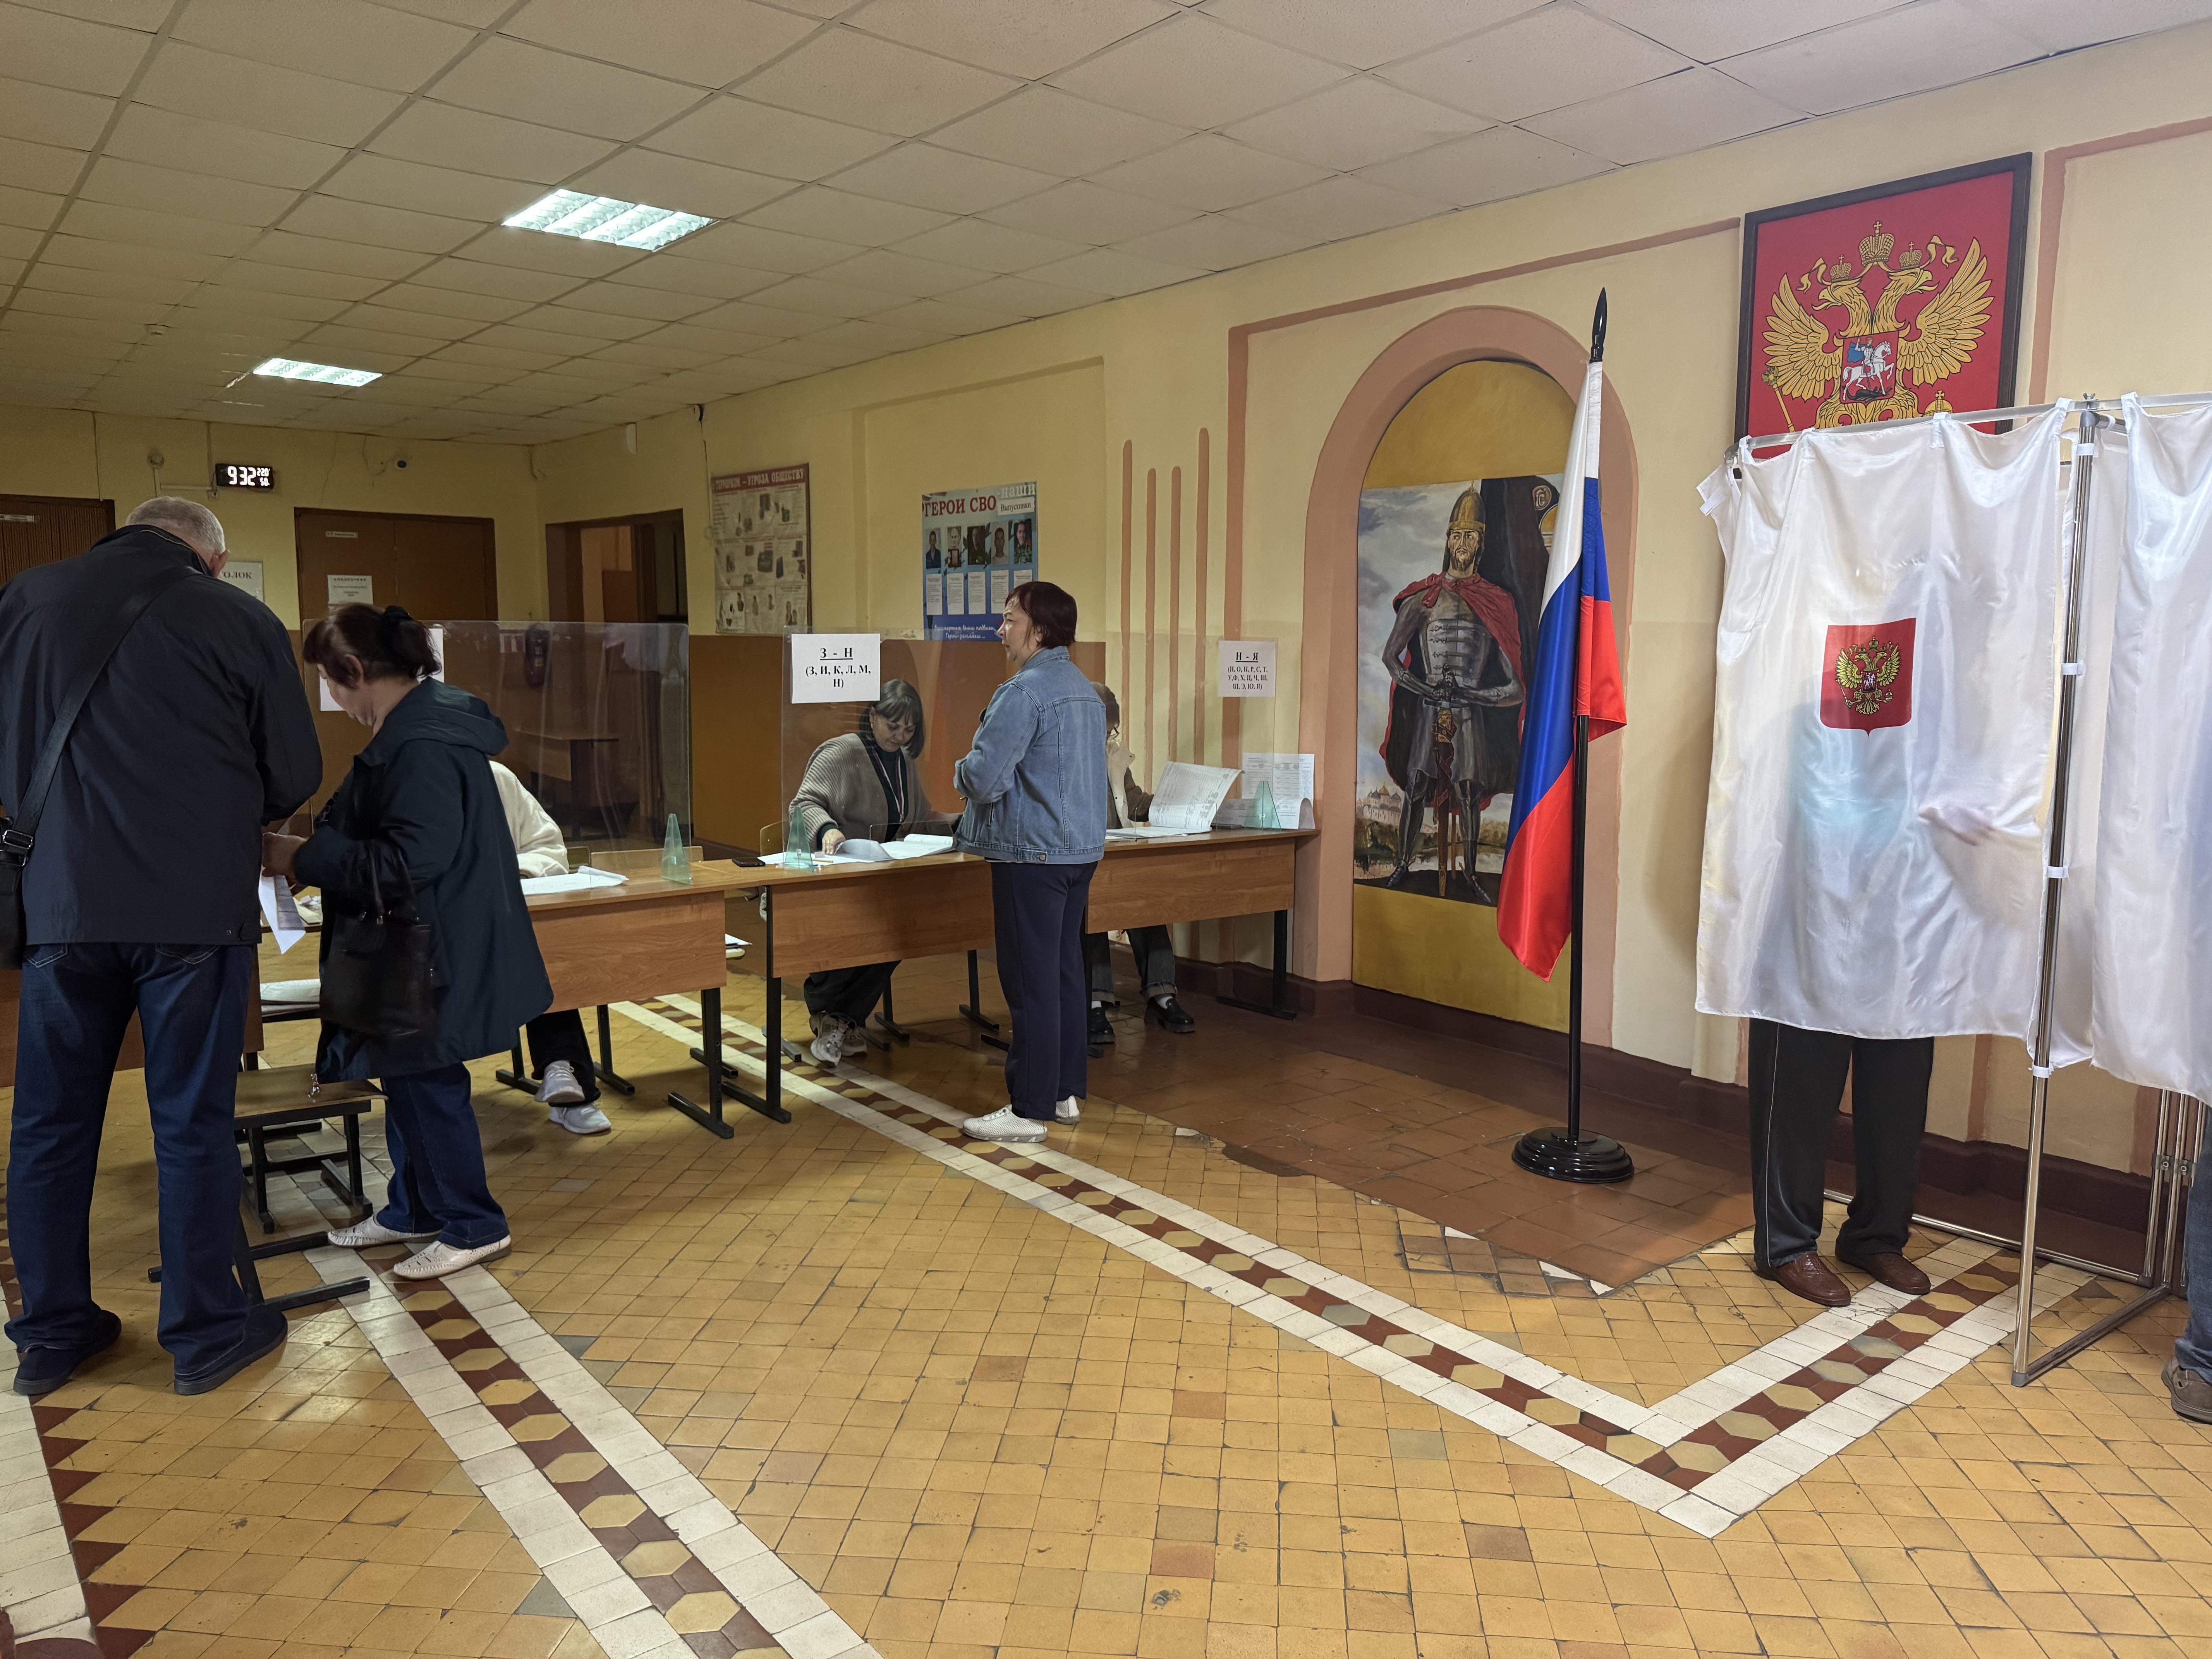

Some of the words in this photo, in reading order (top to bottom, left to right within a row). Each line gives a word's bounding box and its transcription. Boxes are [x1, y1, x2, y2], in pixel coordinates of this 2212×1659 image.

[747, 472, 769, 486] УГРОЗА
[771, 468, 804, 483] ОБЩЕСТВУ
[925, 498, 965, 517] ГЕРОИ
[969, 495, 997, 513] СВО
[1001, 502, 1031, 512] Выпускники
[820, 647, 827, 658] З
[844, 647, 853, 658] Н
[1236, 652, 1242, 660] Н
[1253, 652, 1258, 660] Я
[820, 666, 831, 676] И,
[834, 665, 843, 675] К,
[845, 665, 856, 675] Л,
[859, 665, 871, 675] М,
[833, 678, 844, 689] Н)
